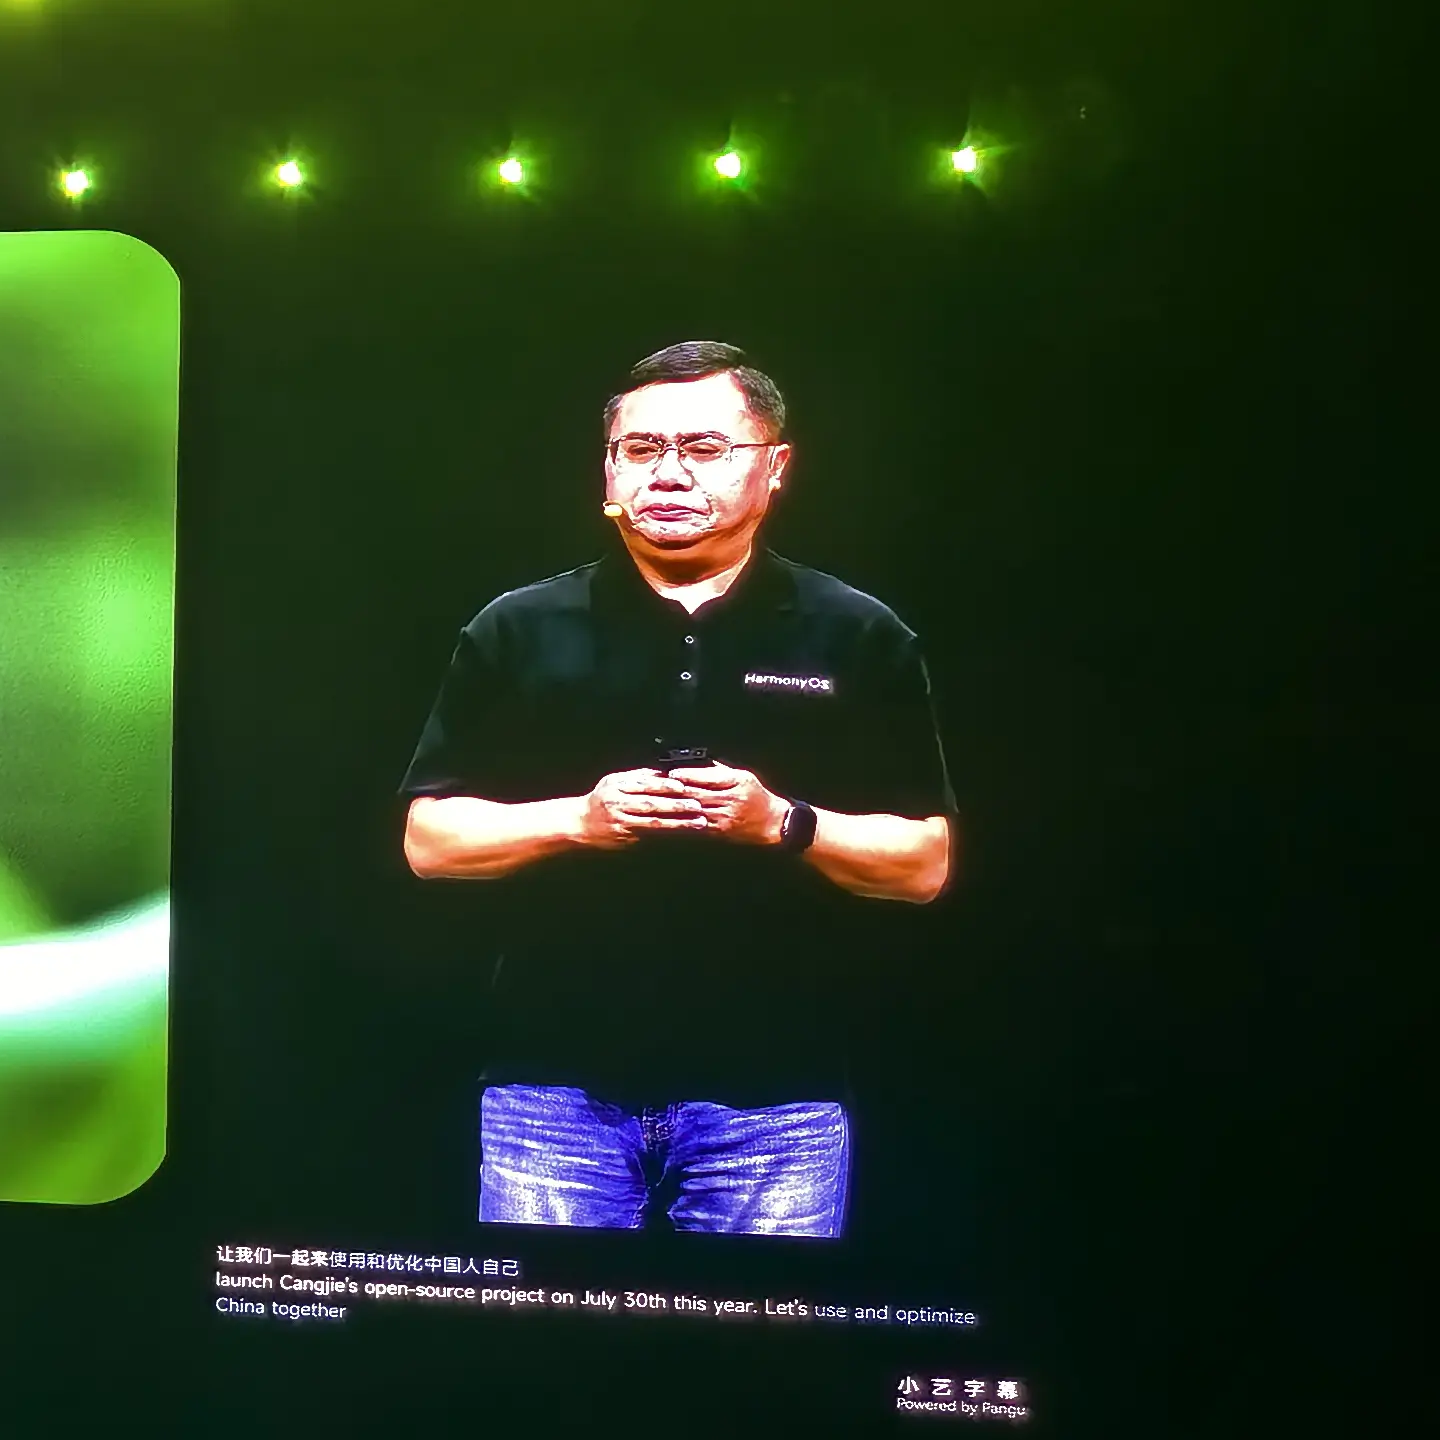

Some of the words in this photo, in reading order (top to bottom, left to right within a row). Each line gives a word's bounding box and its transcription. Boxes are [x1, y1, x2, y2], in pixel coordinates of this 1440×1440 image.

[216, 1245, 519, 1277] 让我们一起来使用和优化中国人自己
[216, 1271, 272, 1289] launch
[280, 1275, 358, 1296] Cangjie's
[364, 1281, 475, 1298] open-source
[481, 1286, 545, 1306] project
[551, 1291, 574, 1305] on
[580, 1290, 617, 1310] July
[623, 1292, 667, 1309] 30th
[673, 1295, 707, 1312] this
[713, 1299, 758, 1316] year.
[765, 1298, 808, 1316] Let's
[815, 1304, 847, 1318] use
[854, 1305, 888, 1320] and
[895, 1307, 976, 1325] optimize
[216, 1297, 265, 1314] China
[272, 1302, 347, 1319] together
[961, 1400, 979, 1416] by
